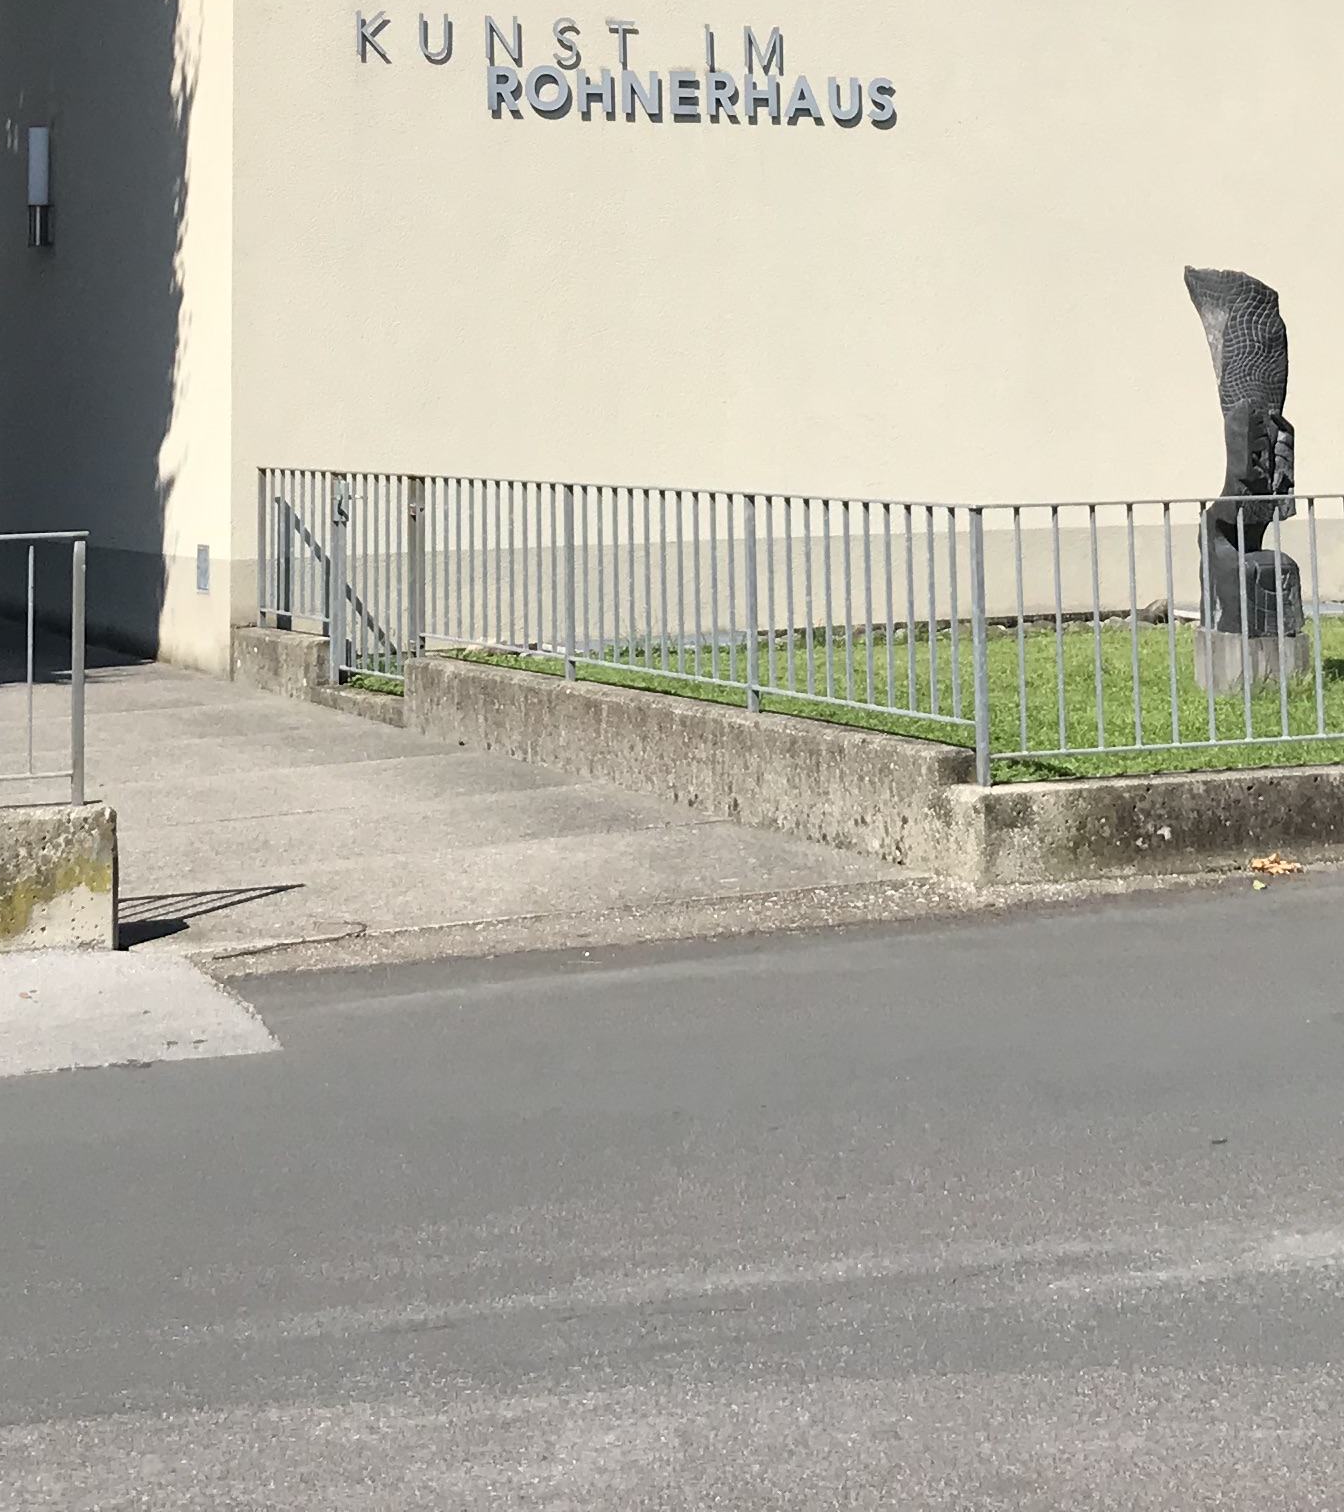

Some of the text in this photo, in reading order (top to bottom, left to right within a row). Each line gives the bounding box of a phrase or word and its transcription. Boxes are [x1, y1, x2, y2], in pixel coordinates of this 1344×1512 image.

[355, 9, 783, 72] KUNST IM
[487, 64, 896, 126] ROHNERHAUS
